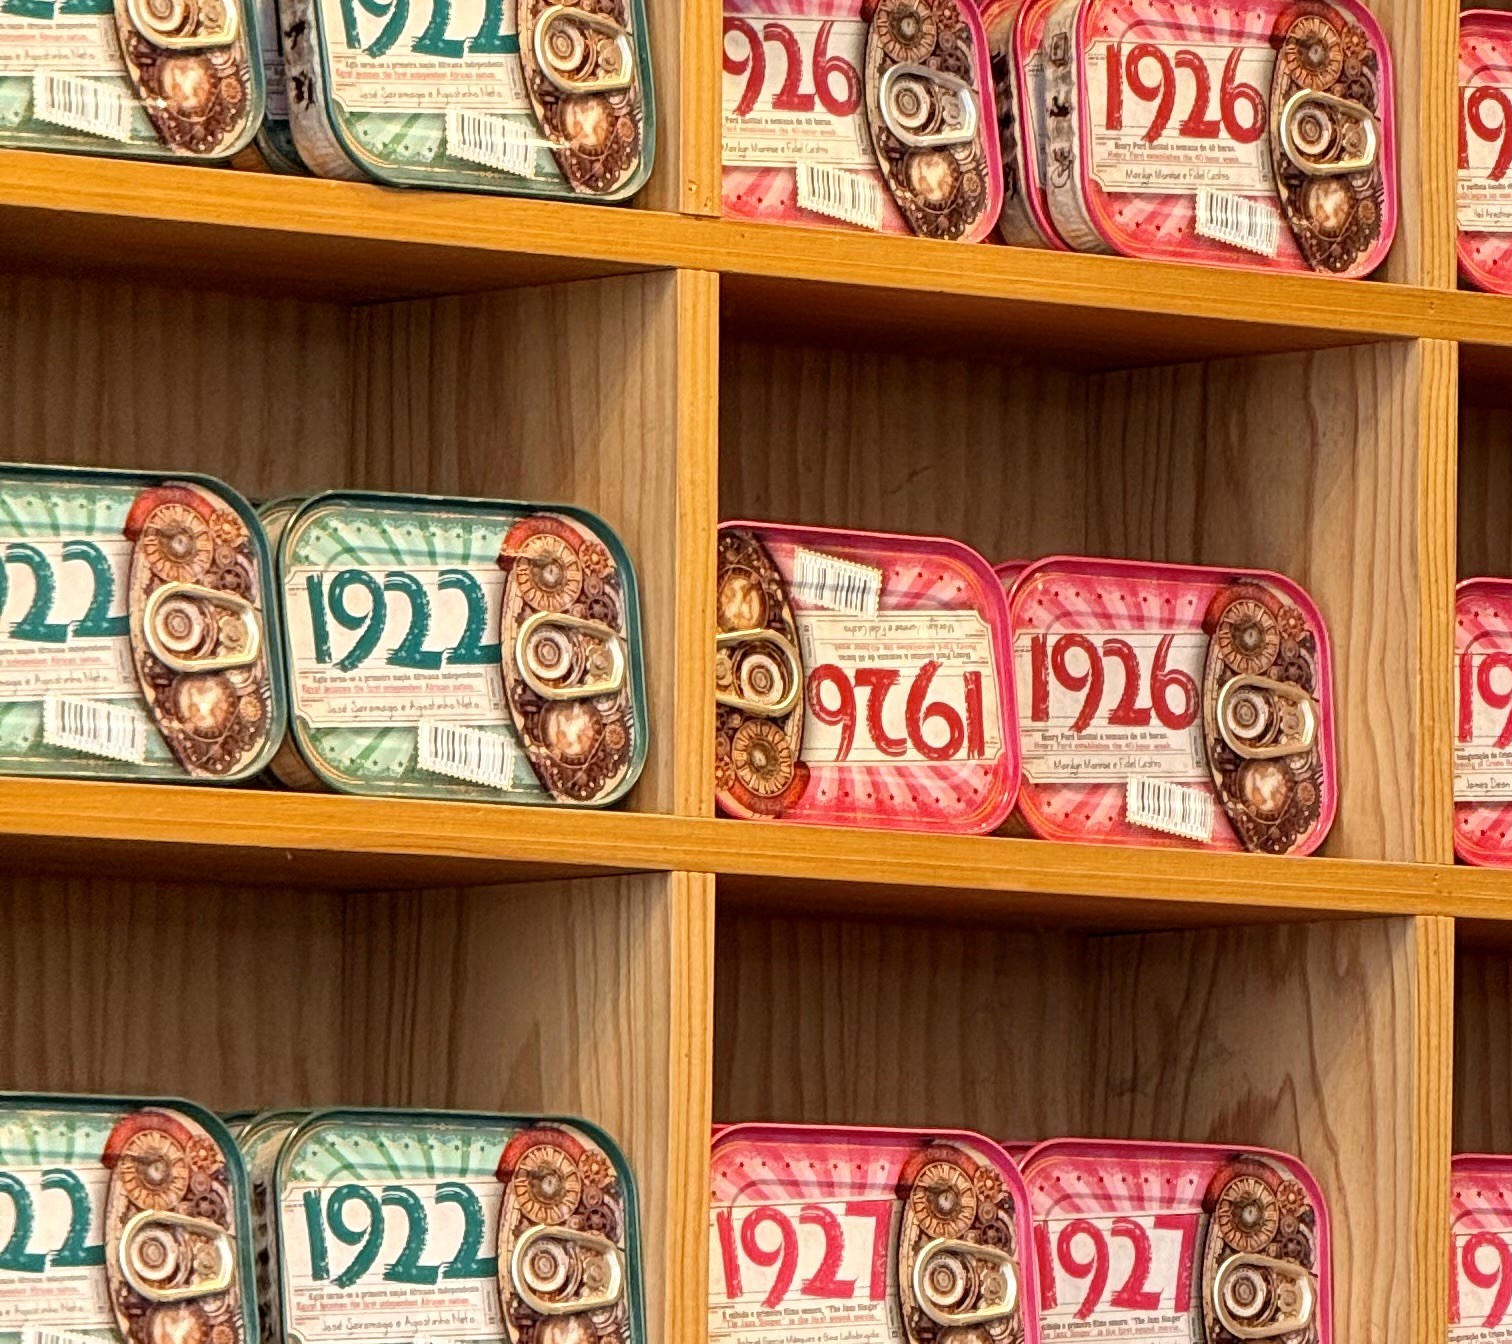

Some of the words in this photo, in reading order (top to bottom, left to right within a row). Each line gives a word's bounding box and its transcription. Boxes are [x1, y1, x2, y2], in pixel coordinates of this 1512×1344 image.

[721, 15, 863, 118] 926
[1104, 42, 1266, 145] 1926
[0, 540, 131, 644] 22
[306, 568, 501, 673] 1922
[807, 661, 986, 763] 1926
[1030, 633, 1200, 733] 1926
[0, 1167, 105, 1274] 22
[303, 1181, 499, 1288] 1922
[716, 1199, 893, 1310] 1927
[1038, 1213, 1197, 1321] 1927
